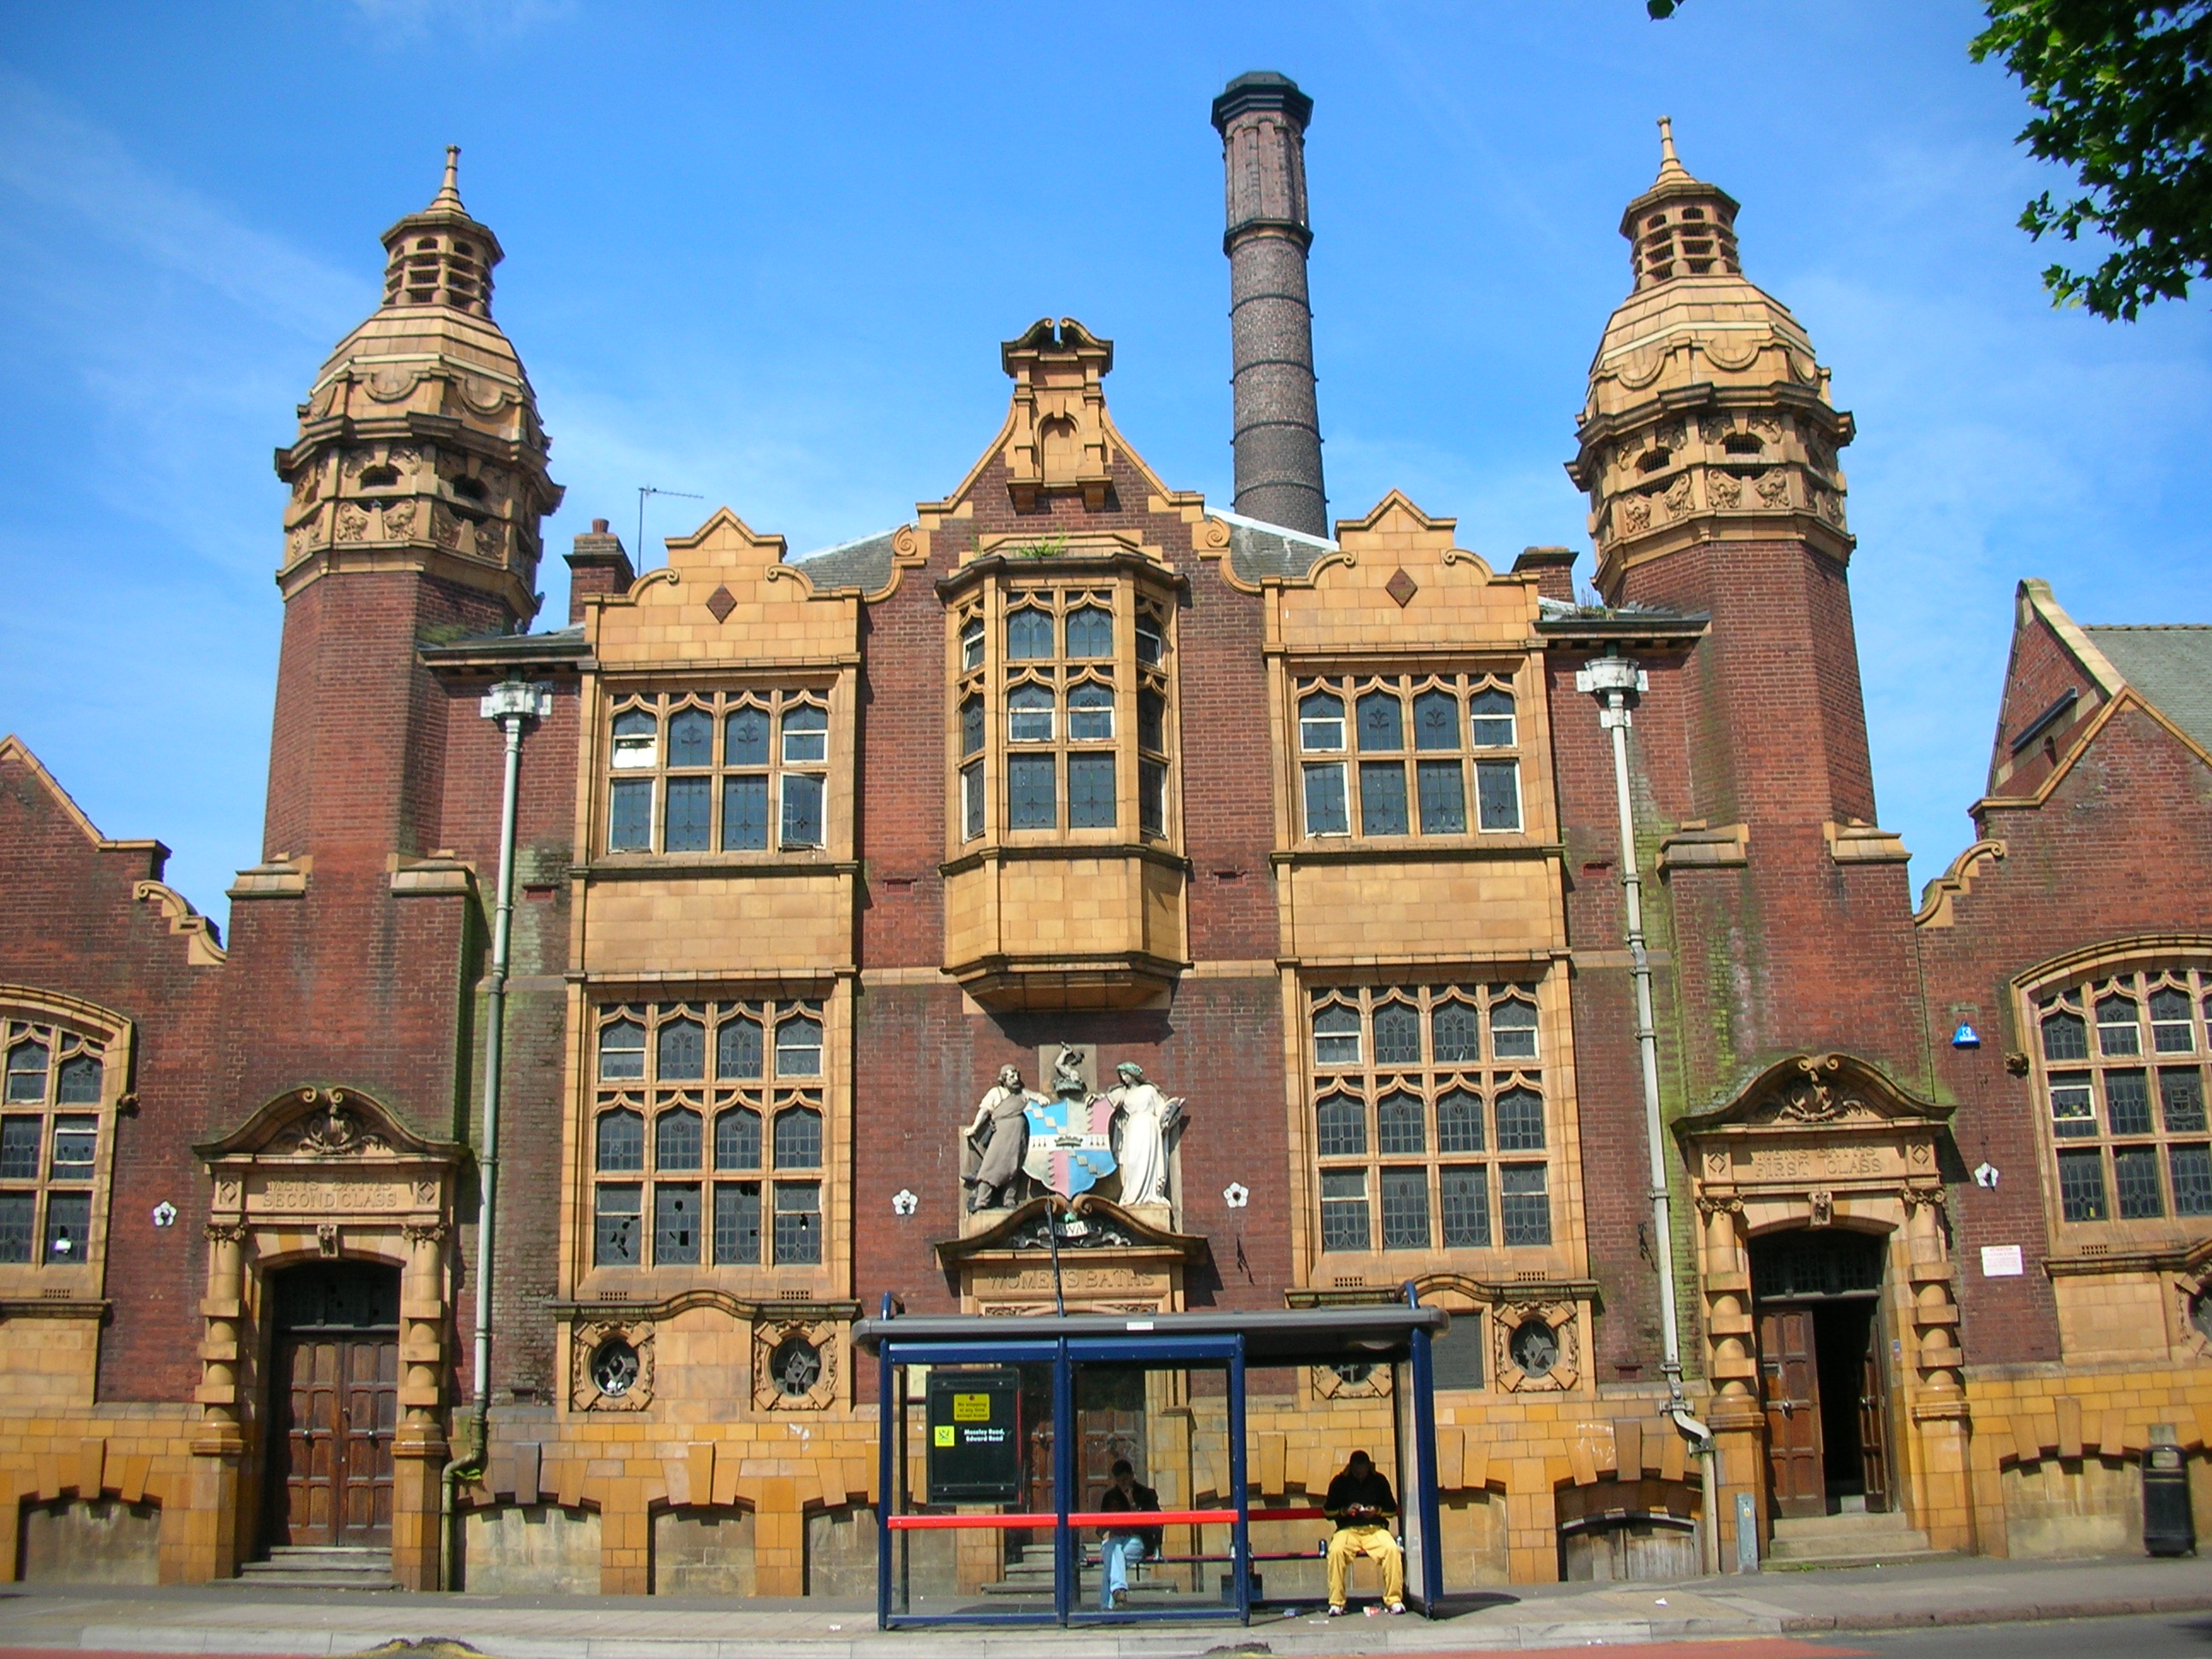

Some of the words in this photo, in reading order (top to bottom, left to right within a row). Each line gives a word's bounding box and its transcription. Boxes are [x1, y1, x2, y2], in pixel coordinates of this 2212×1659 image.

[1817, 1143, 1876, 1158] BATHS
[1755, 1161, 1810, 1178] FIRST
[1826, 1158, 1882, 1174] CLASS
[332, 1177, 393, 1191] BATHS
[262, 1193, 336, 1208] SECOND
[341, 1193, 398, 1208] CLASS
[988, 1269, 1080, 1289] WOME'S
[1086, 1268, 1155, 1289] BATHS
